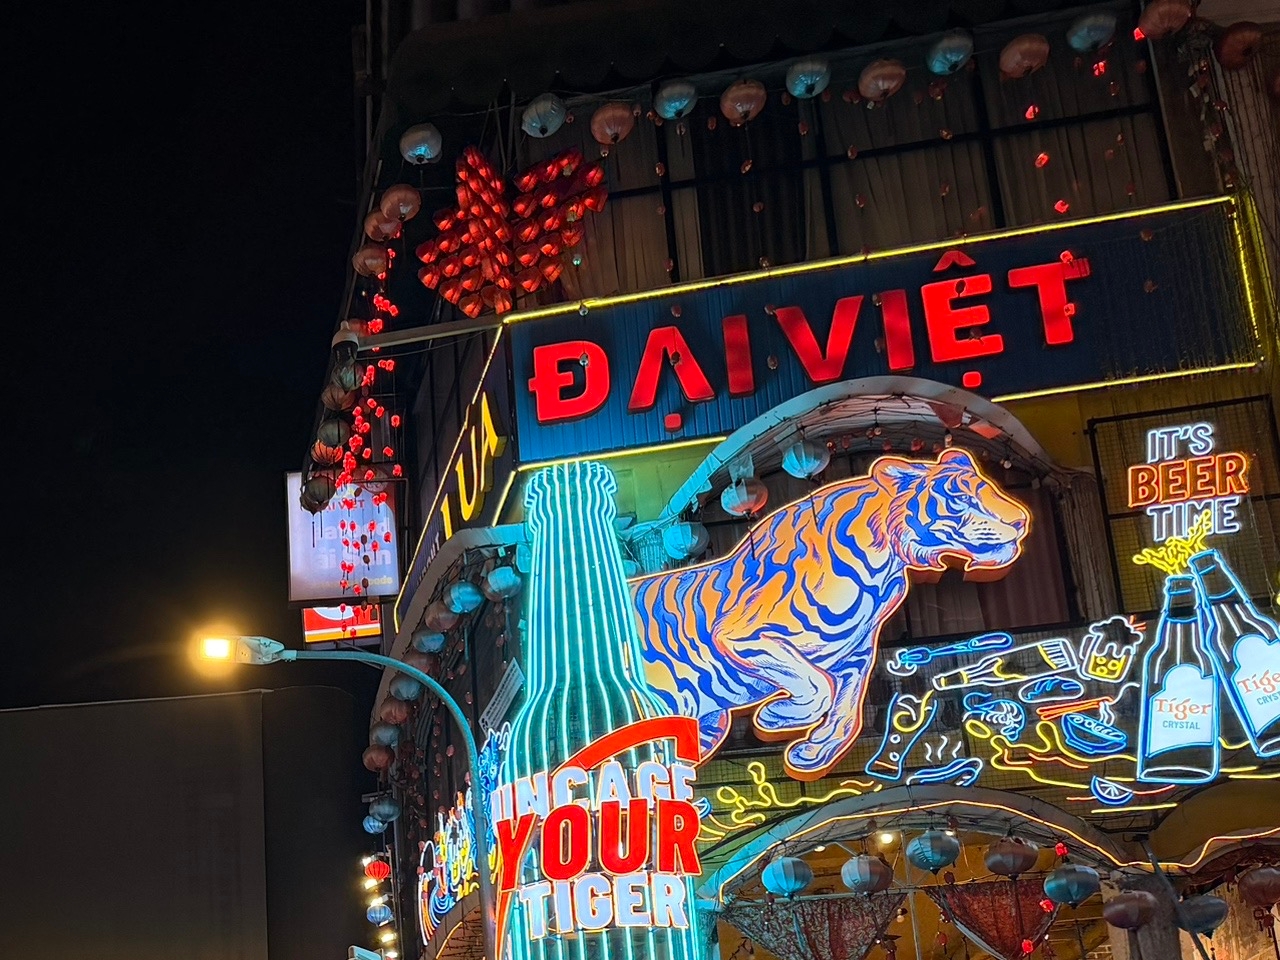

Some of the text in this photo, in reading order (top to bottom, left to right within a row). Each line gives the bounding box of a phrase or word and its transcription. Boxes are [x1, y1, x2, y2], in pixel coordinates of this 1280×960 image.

[528, 250, 1092, 432] ĐẠI VIỆT
[1146, 421, 1214, 462] IT'S
[1126, 451, 1249, 508] BEER
[1146, 496, 1241, 542] TIME
[1155, 697, 1212, 720] Tiger
[1256, 690, 1280, 706] CRYS
[1162, 720, 1200, 730] CRYSTAL
[496, 797, 703, 893] YOUR
[519, 873, 690, 940] TIGER
